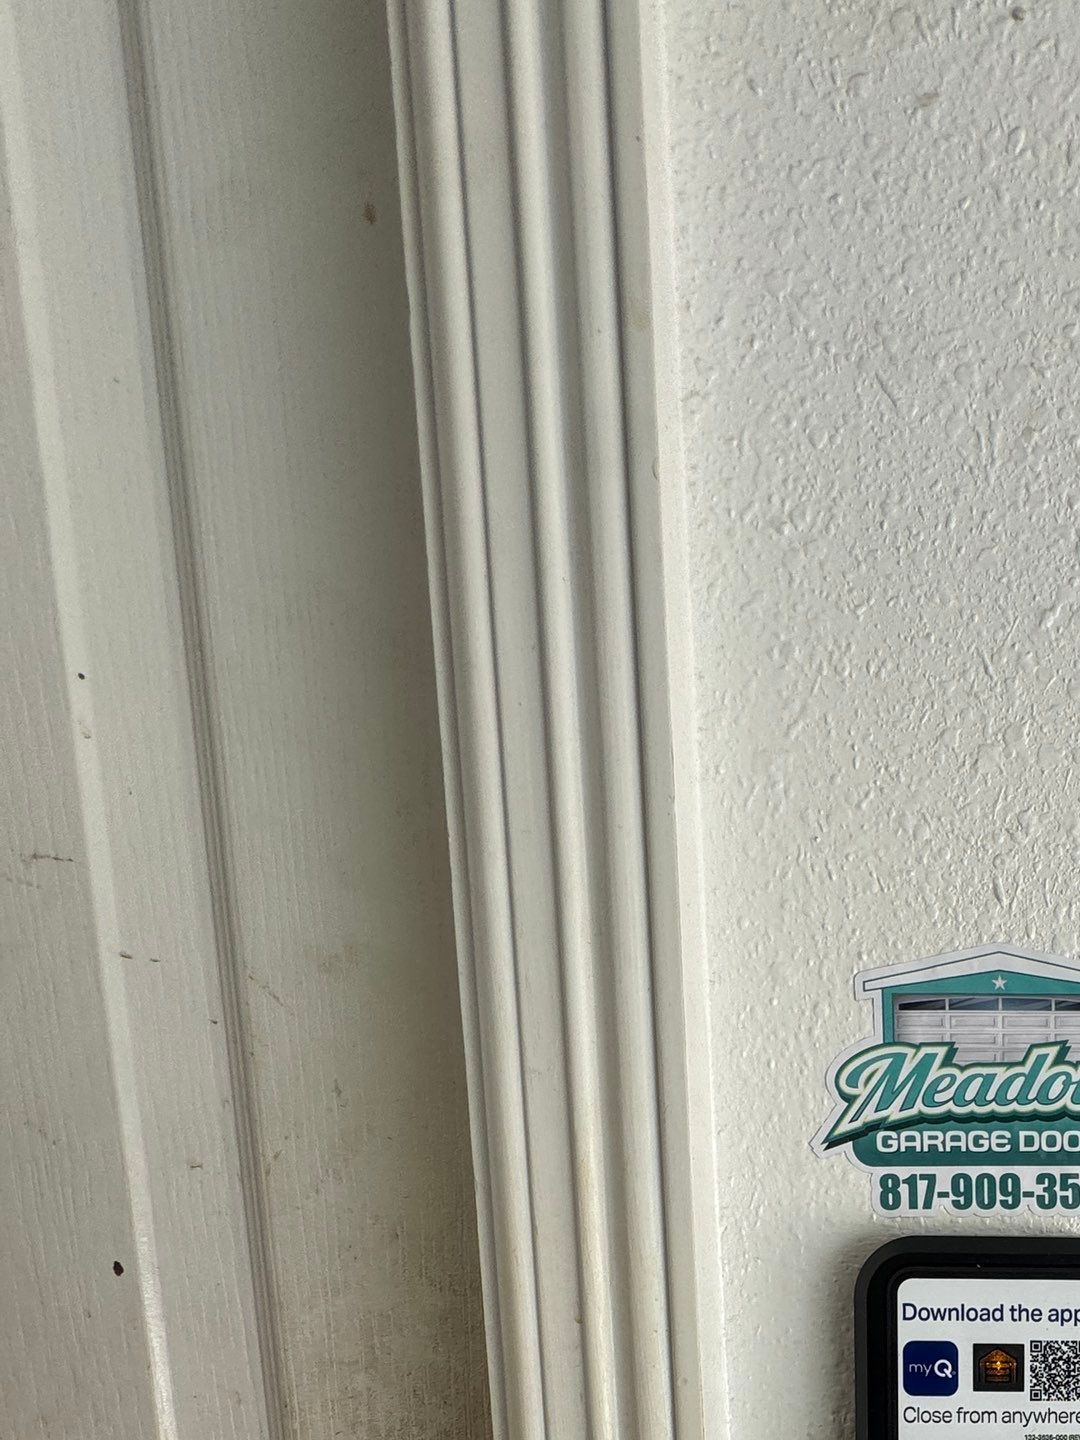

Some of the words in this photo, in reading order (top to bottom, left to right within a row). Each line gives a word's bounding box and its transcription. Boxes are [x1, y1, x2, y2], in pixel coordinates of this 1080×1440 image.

[876, 1130, 1012, 1153] GARAGE
[902, 1302, 1004, 1322] Download
[1009, 1303, 1043, 1323] the
[903, 1406, 953, 1424] Close
[956, 1406, 998, 1424] from
